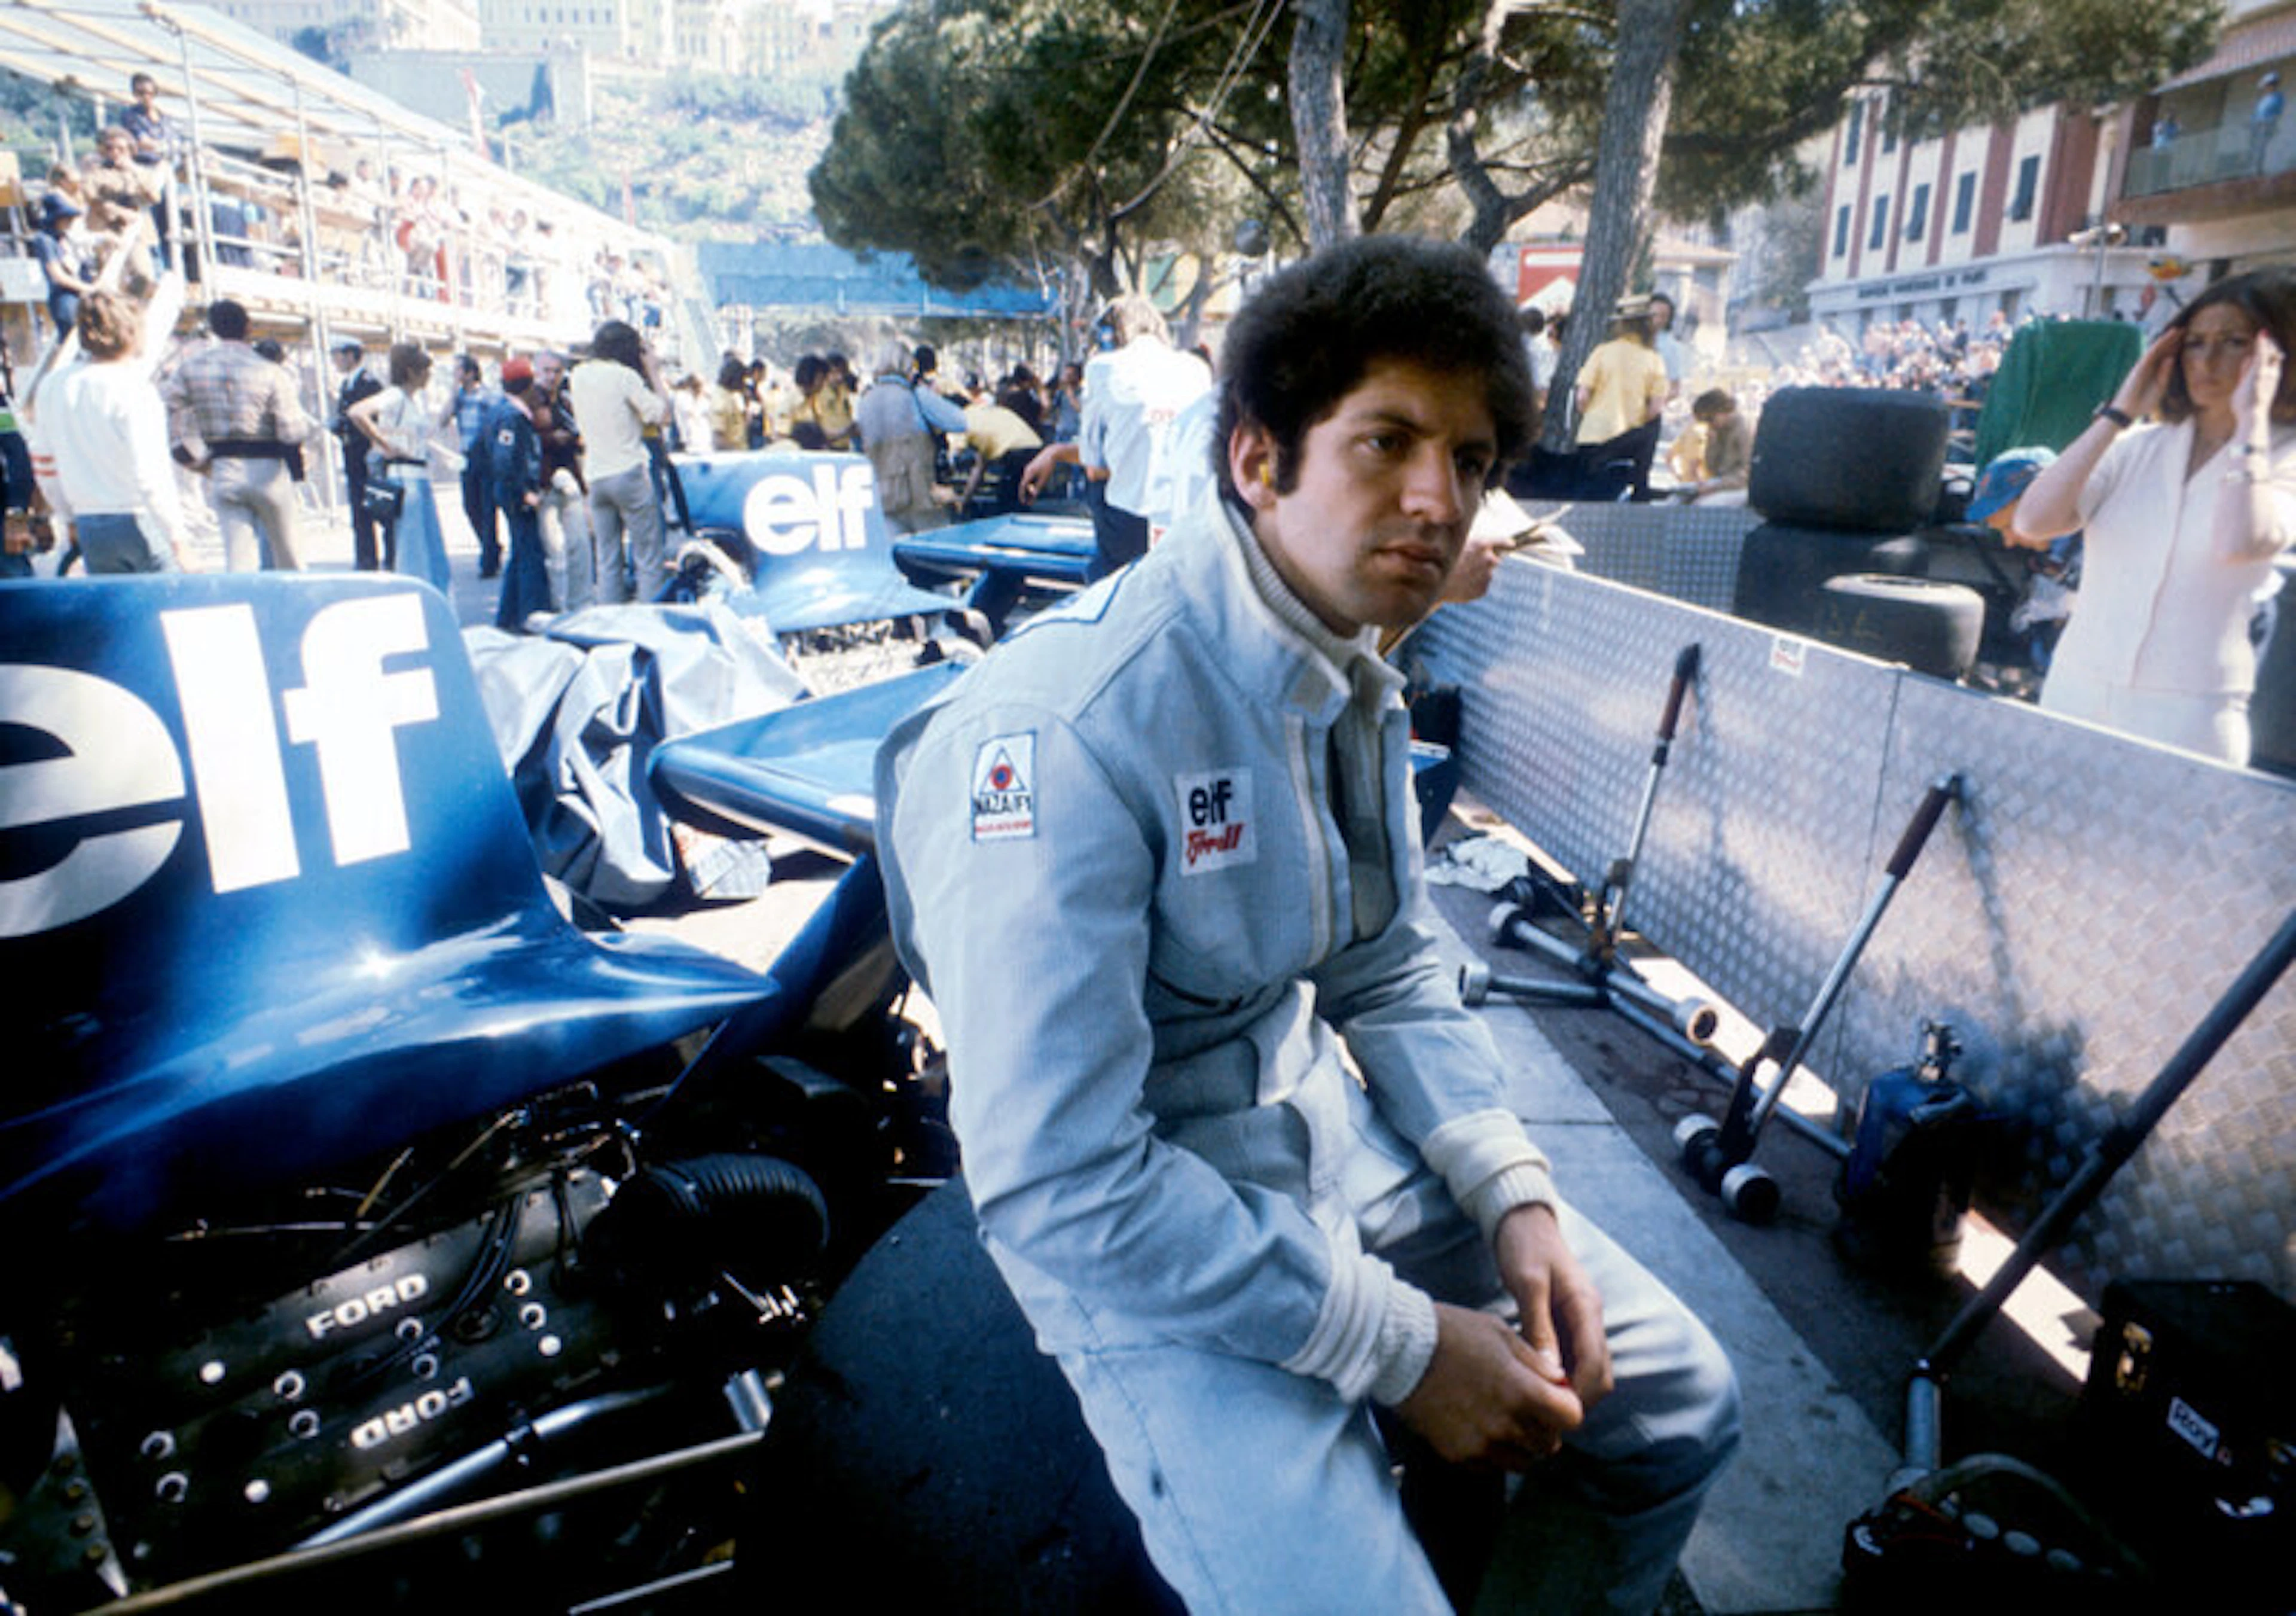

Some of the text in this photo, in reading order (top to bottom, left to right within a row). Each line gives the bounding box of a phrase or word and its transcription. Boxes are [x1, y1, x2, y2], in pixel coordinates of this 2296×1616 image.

[744, 464, 874, 555] elf
[0, 592, 440, 938] elf
[1189, 779, 1234, 827] elf
[306, 1273, 429, 1339] FORD
[351, 1376, 474, 1449] FORD
